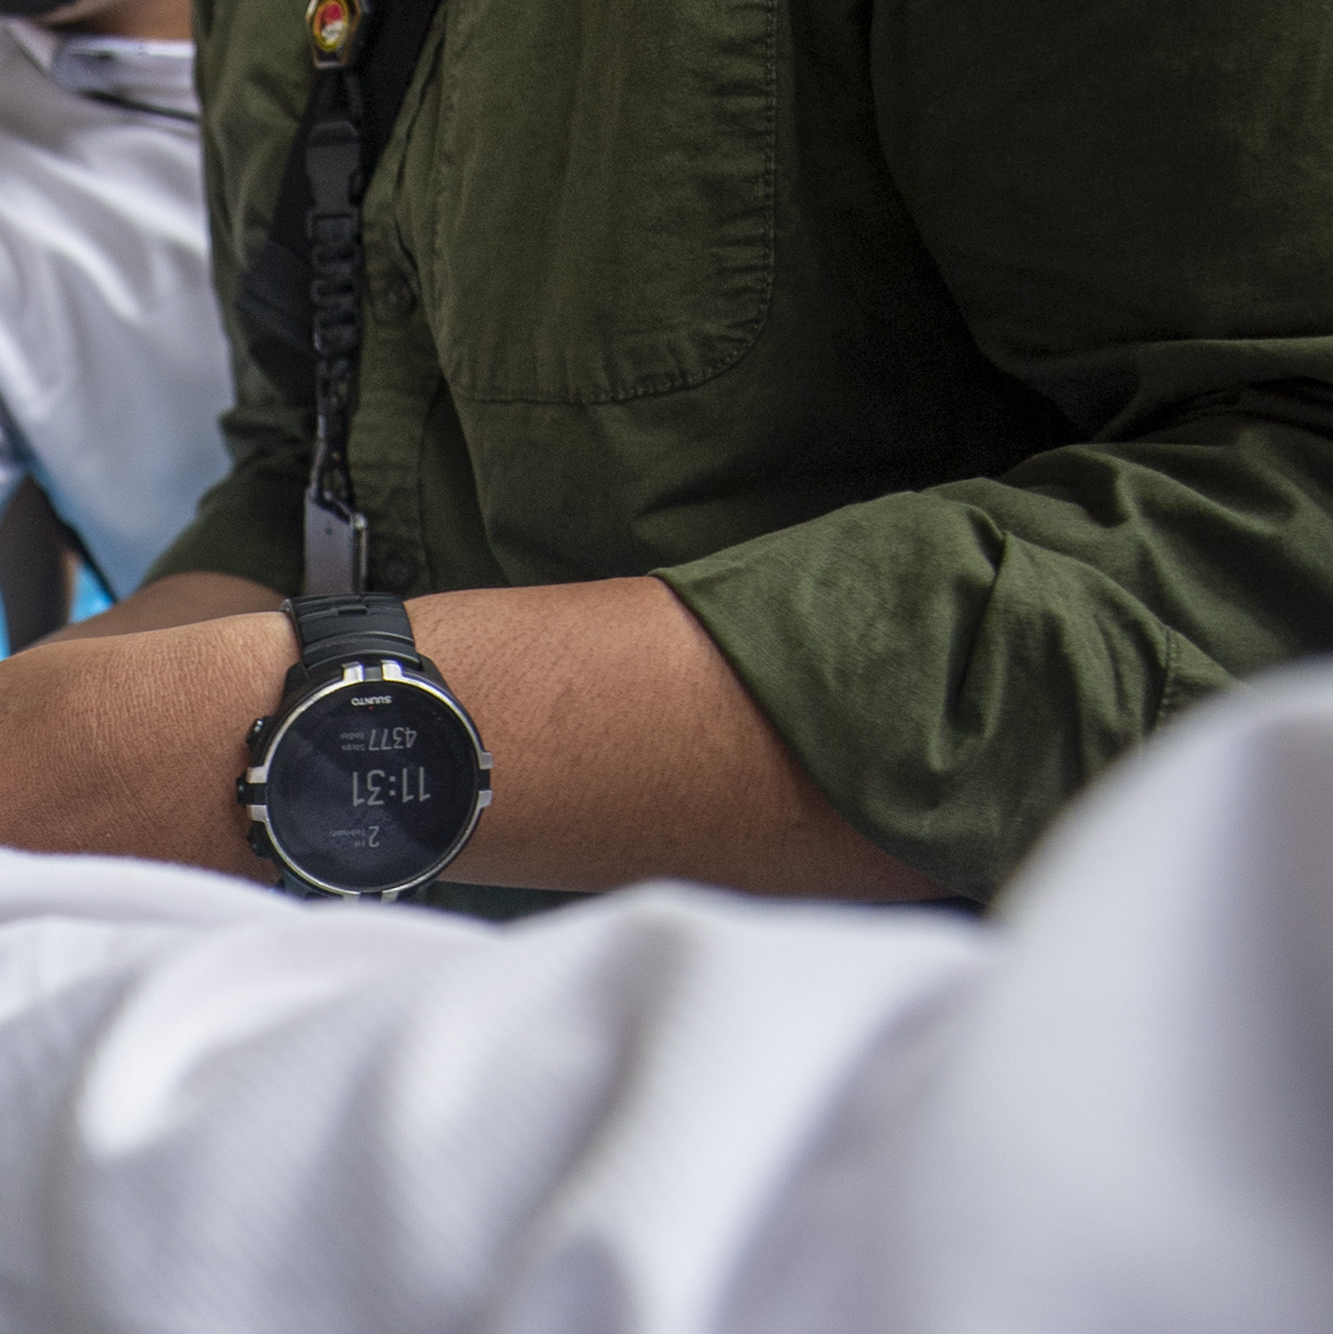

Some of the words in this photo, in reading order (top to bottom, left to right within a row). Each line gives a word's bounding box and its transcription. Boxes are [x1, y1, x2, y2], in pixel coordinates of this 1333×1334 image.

[350, 695, 393, 706] SUUNTO
[368, 727, 417, 751] 4377
[352, 766, 431, 807] 11:31
[368, 826, 380, 848] 2
